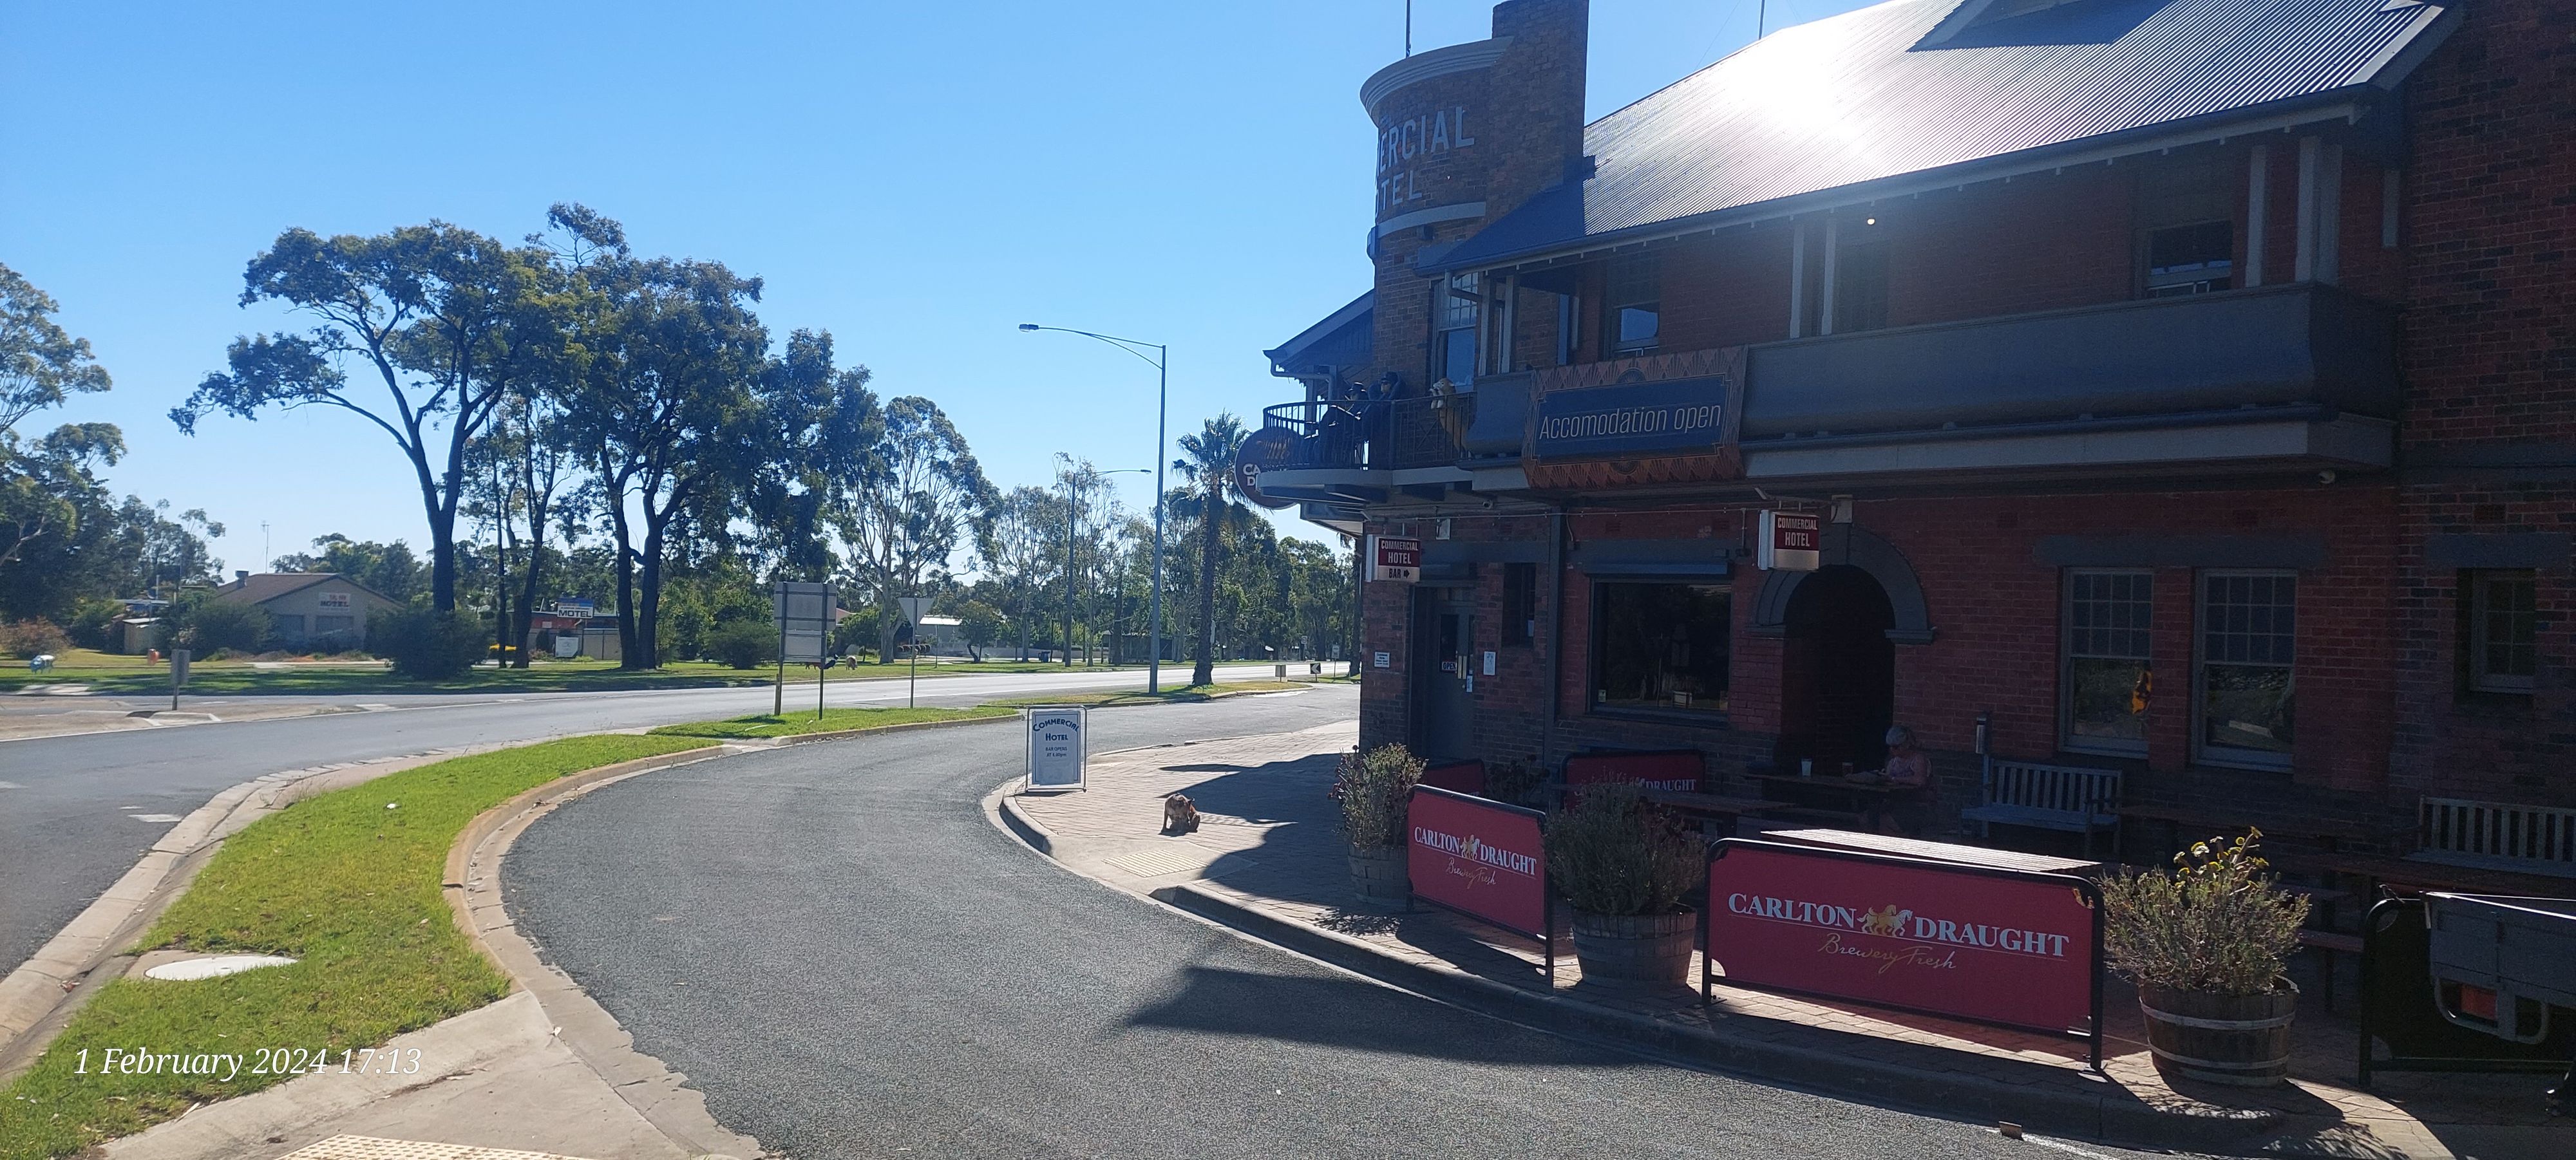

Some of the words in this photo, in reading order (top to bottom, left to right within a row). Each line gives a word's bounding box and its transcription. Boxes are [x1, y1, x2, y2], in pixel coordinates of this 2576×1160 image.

[1539, 407, 1667, 440] Accomodation
[1674, 404, 1721, 434] open
[1777, 517, 1817, 530] COMMERCIAL
[1381, 540, 1419, 551] COMMERCIAL
[1785, 532, 1810, 547] HOTEL
[1388, 552, 1412, 565] HOTEL
[1388, 568, 1401, 579] BAR
[1032, 718, 1079, 732] COMMERCIAL
[1045, 733, 1068, 741] HOTEL
[1645, 779, 1696, 792] DRAUGHT
[1414, 827, 1461, 854] CARLTON
[1480, 843, 1537, 875] DRAUGHT
[1446, 857, 1476, 890] Brewery
[1472, 866, 1497, 885] Fresh
[1728, 893, 1857, 928] CARLTON
[1915, 916, 2070, 957] DRAUGHT
[1817, 933, 1898, 974] Brewery
[1899, 945, 1956, 969] Fresh
